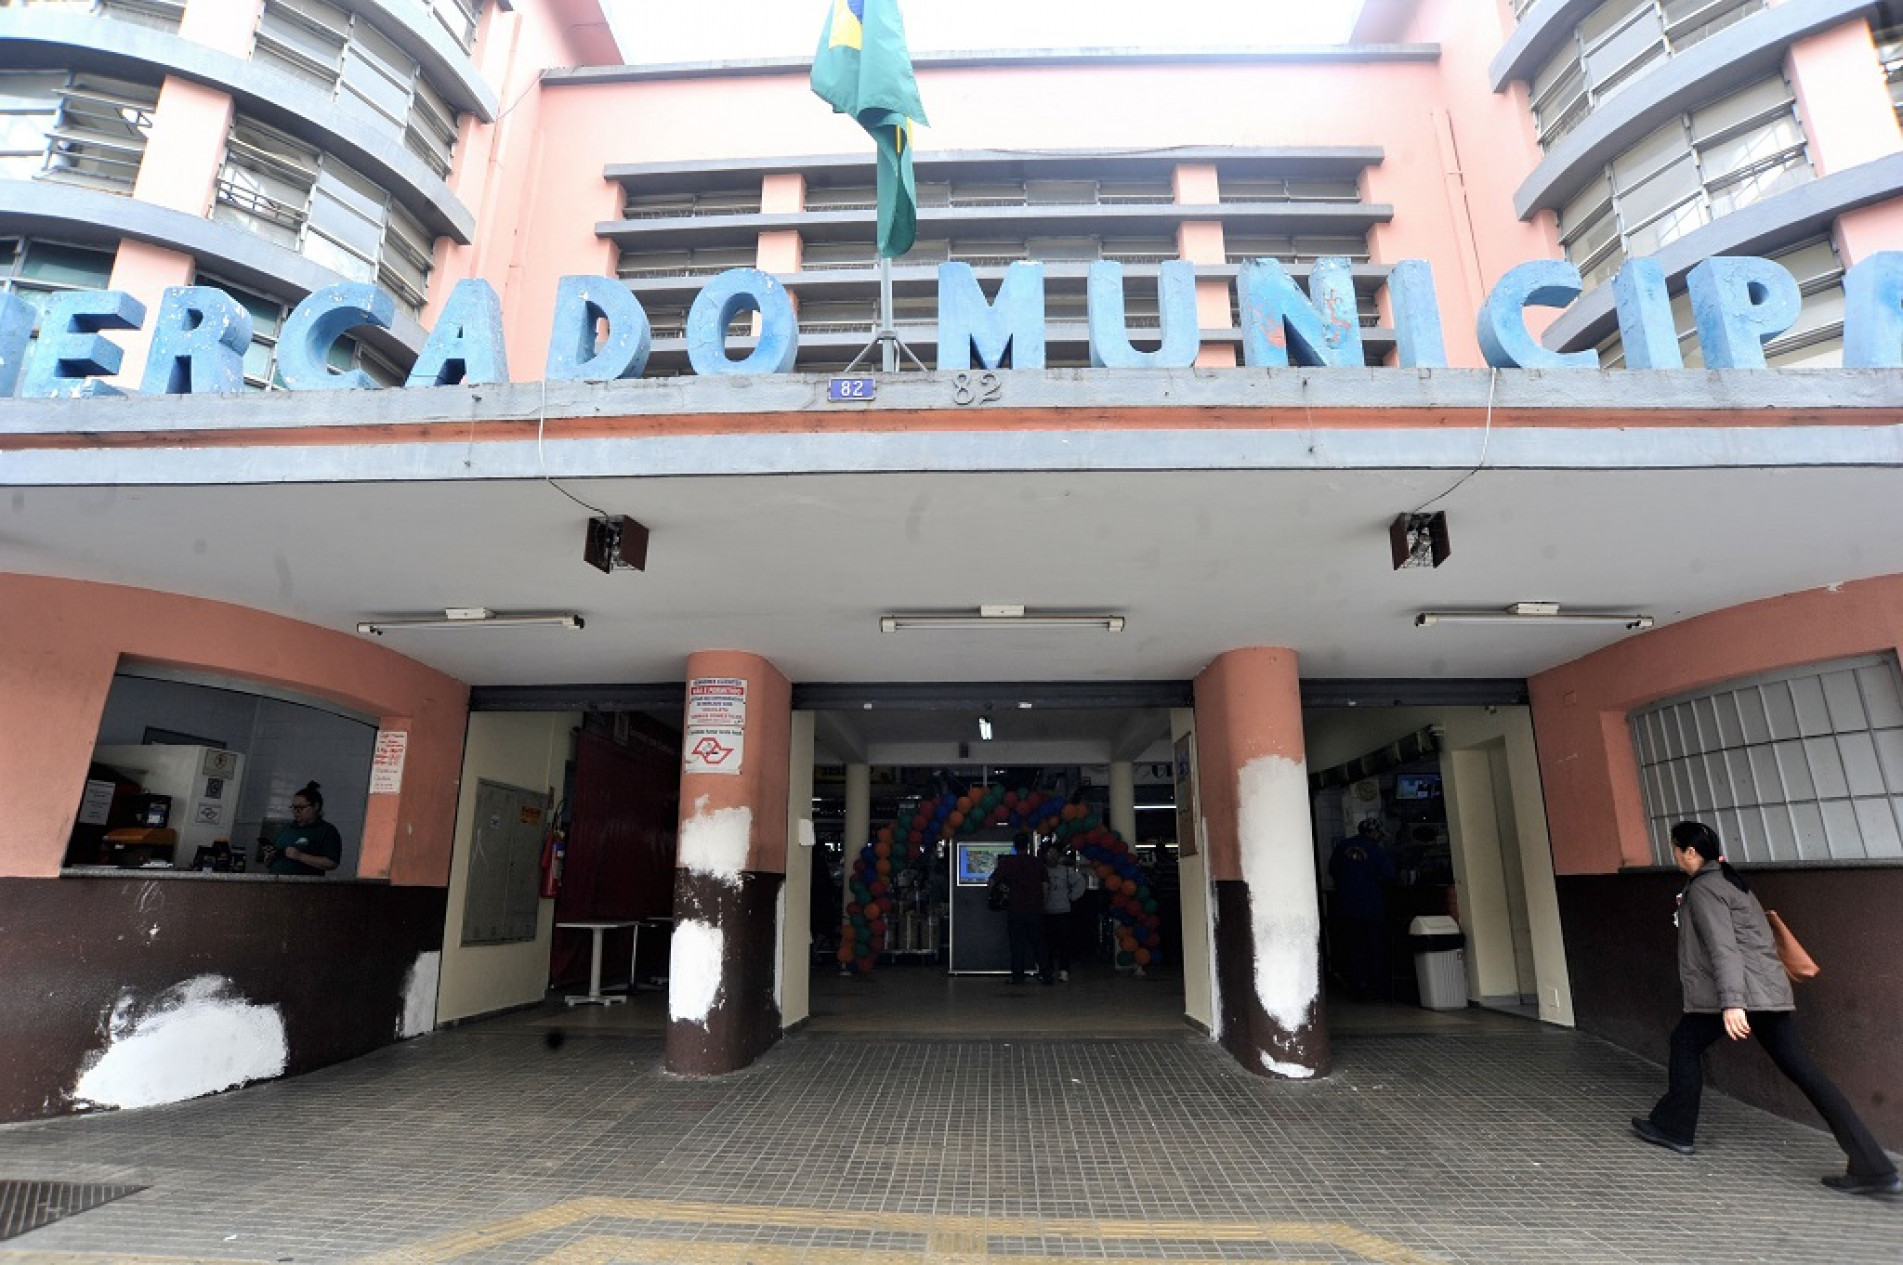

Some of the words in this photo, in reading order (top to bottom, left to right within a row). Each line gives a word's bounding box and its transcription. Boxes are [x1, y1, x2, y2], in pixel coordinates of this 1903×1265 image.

[0, 267, 798, 398] ERCADO
[841, 380, 863, 397] 82
[953, 372, 1002, 406] 82
